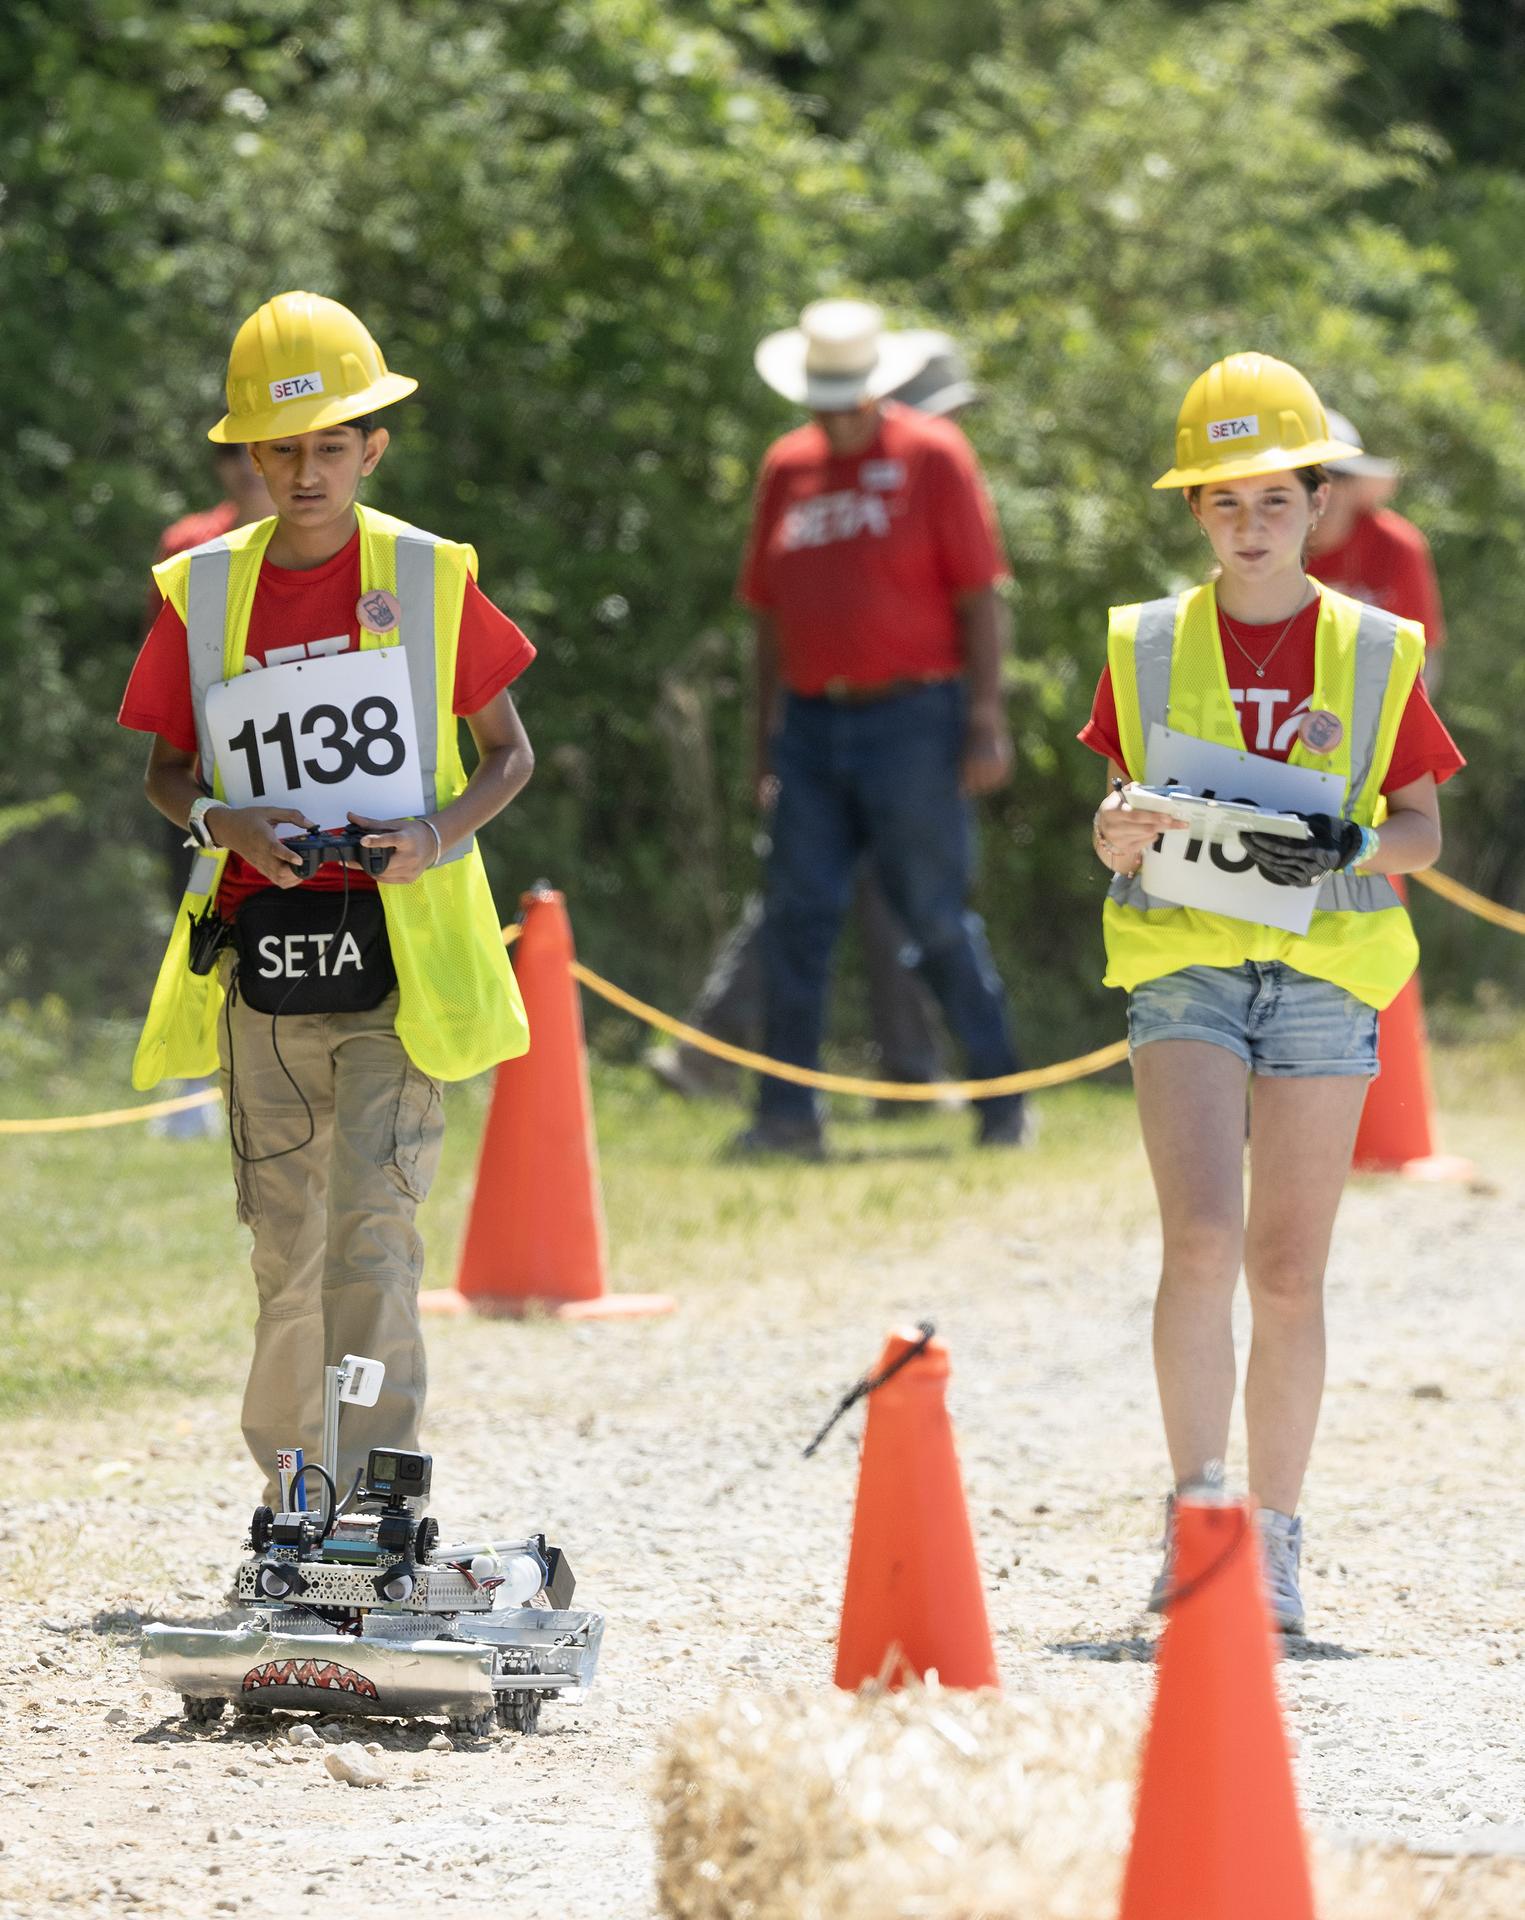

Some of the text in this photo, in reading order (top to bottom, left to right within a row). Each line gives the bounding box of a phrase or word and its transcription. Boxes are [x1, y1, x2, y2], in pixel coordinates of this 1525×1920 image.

[274, 378, 315, 399] SETA
[1211, 420, 1250, 439] SETA
[228, 695, 406, 798] 1138
[258, 931, 363, 979] SETA
